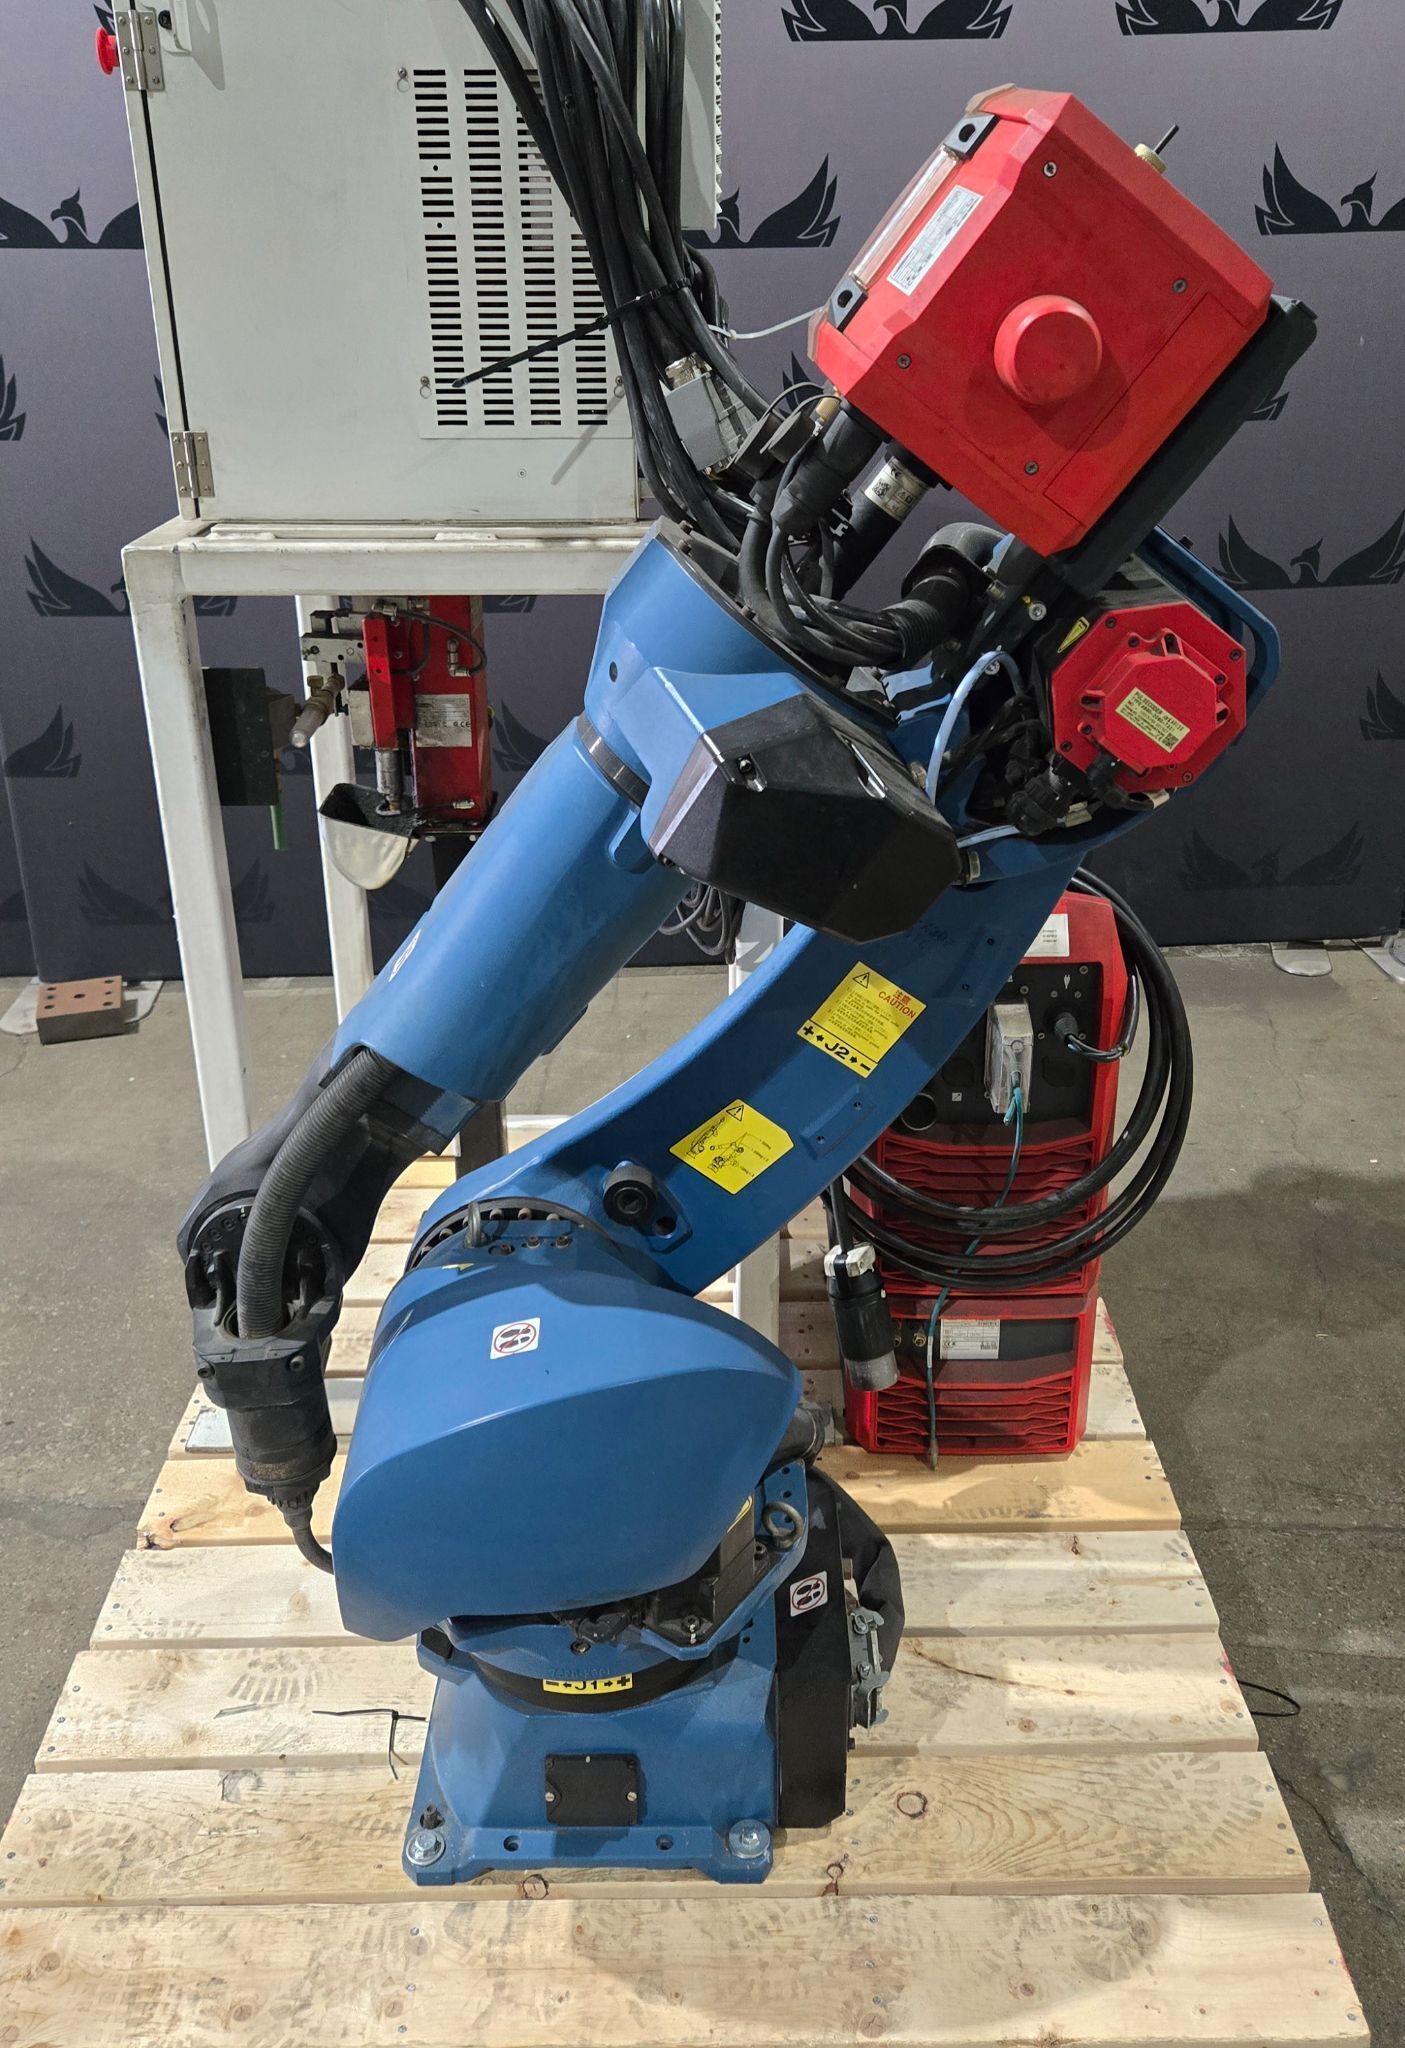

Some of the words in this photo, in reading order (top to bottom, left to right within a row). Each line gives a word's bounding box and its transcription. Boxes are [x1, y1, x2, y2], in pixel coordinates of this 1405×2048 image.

[879, 991, 916, 1019] CAUTION
[825, 1042, 850, 1060] J2
[575, 1680, 597, 1691] J1
